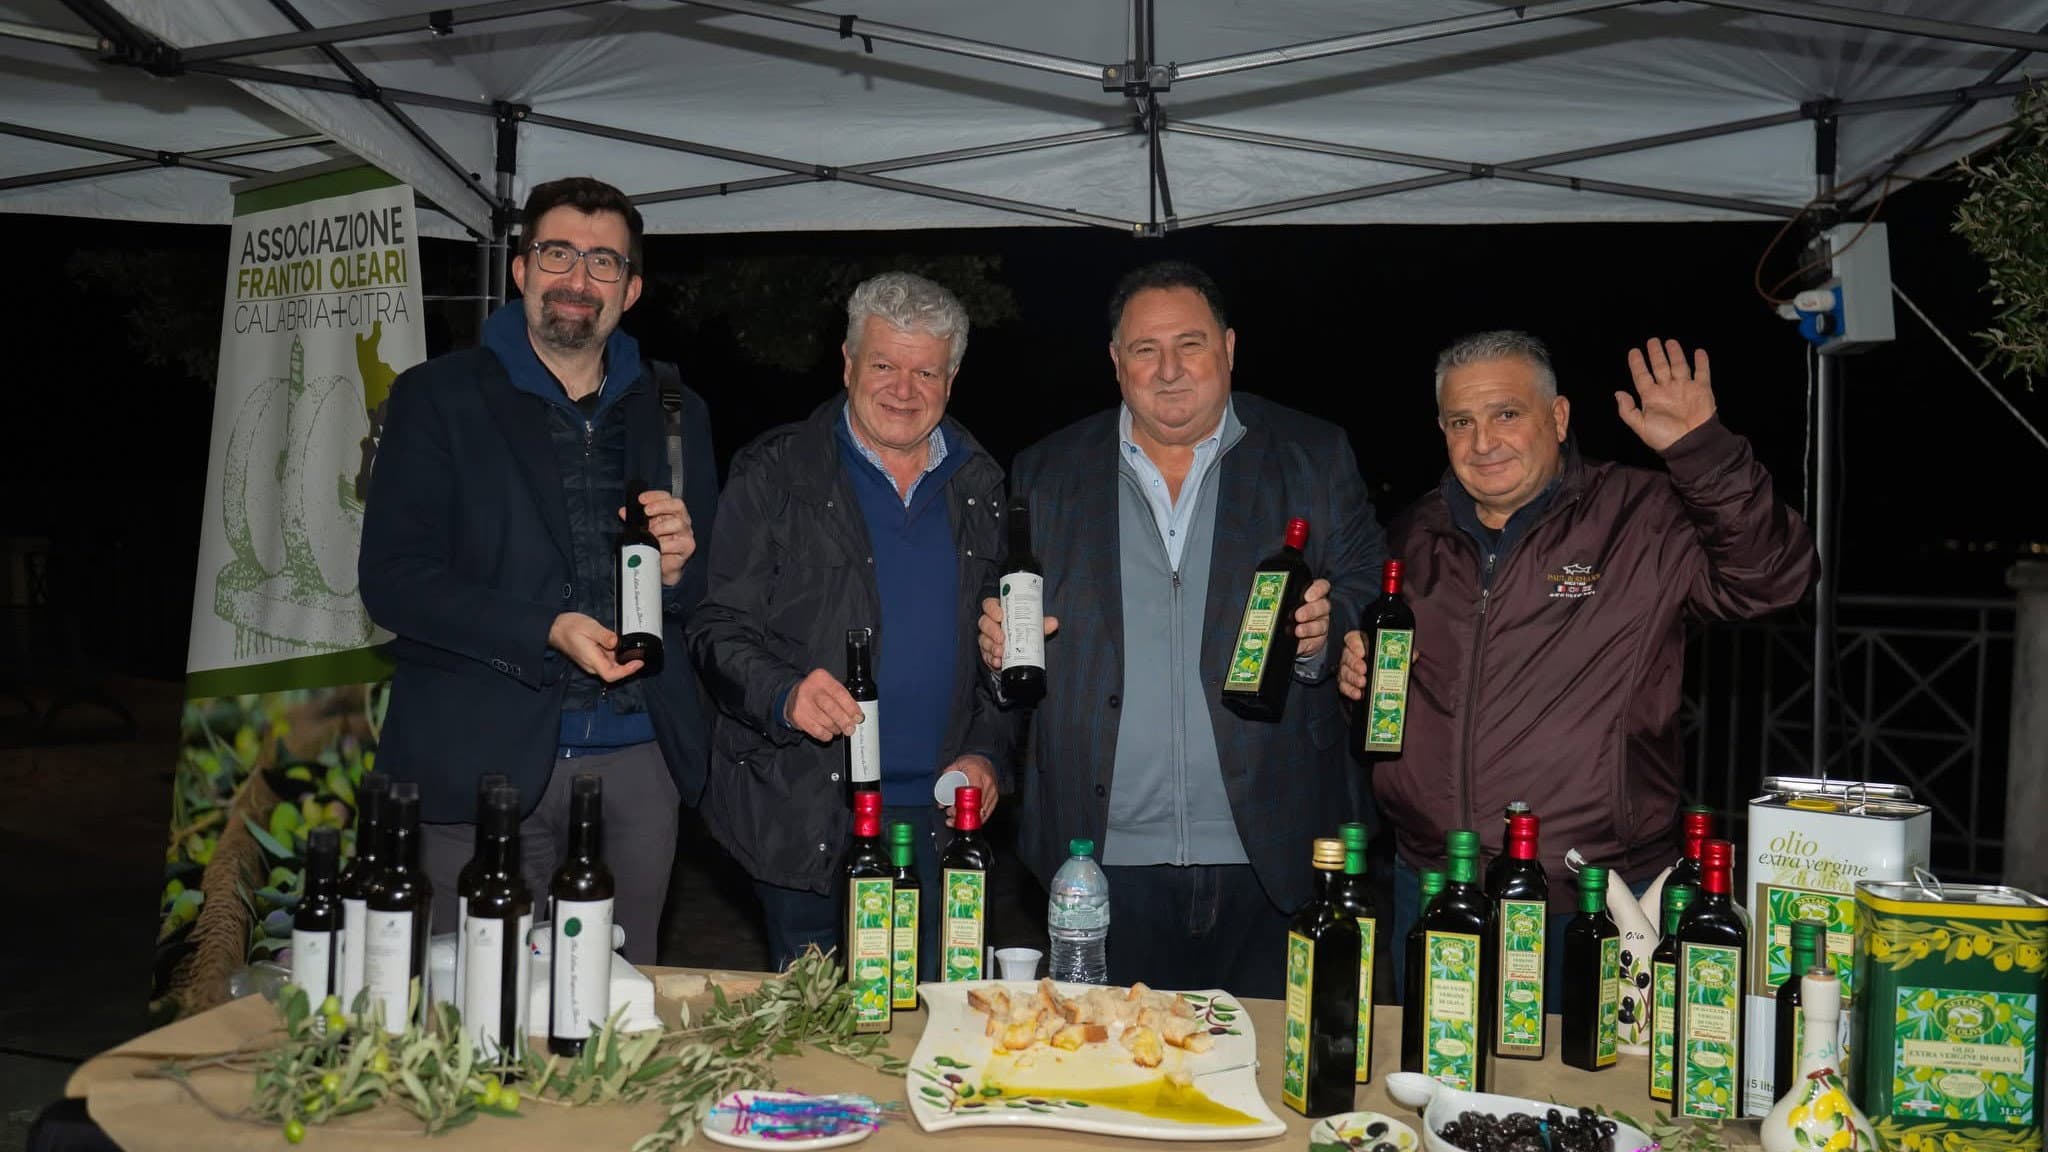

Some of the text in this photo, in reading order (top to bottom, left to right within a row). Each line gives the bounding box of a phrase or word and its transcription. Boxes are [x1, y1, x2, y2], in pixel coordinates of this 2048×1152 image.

[241, 206, 405, 265] ASSOCIAZIONE
[237, 248, 408, 299] FRANTOI OLEARI
[1770, 831, 1818, 857] olio
[1758, 852, 1869, 878] extra vergine
[1760, 1079, 1774, 1092] litr
